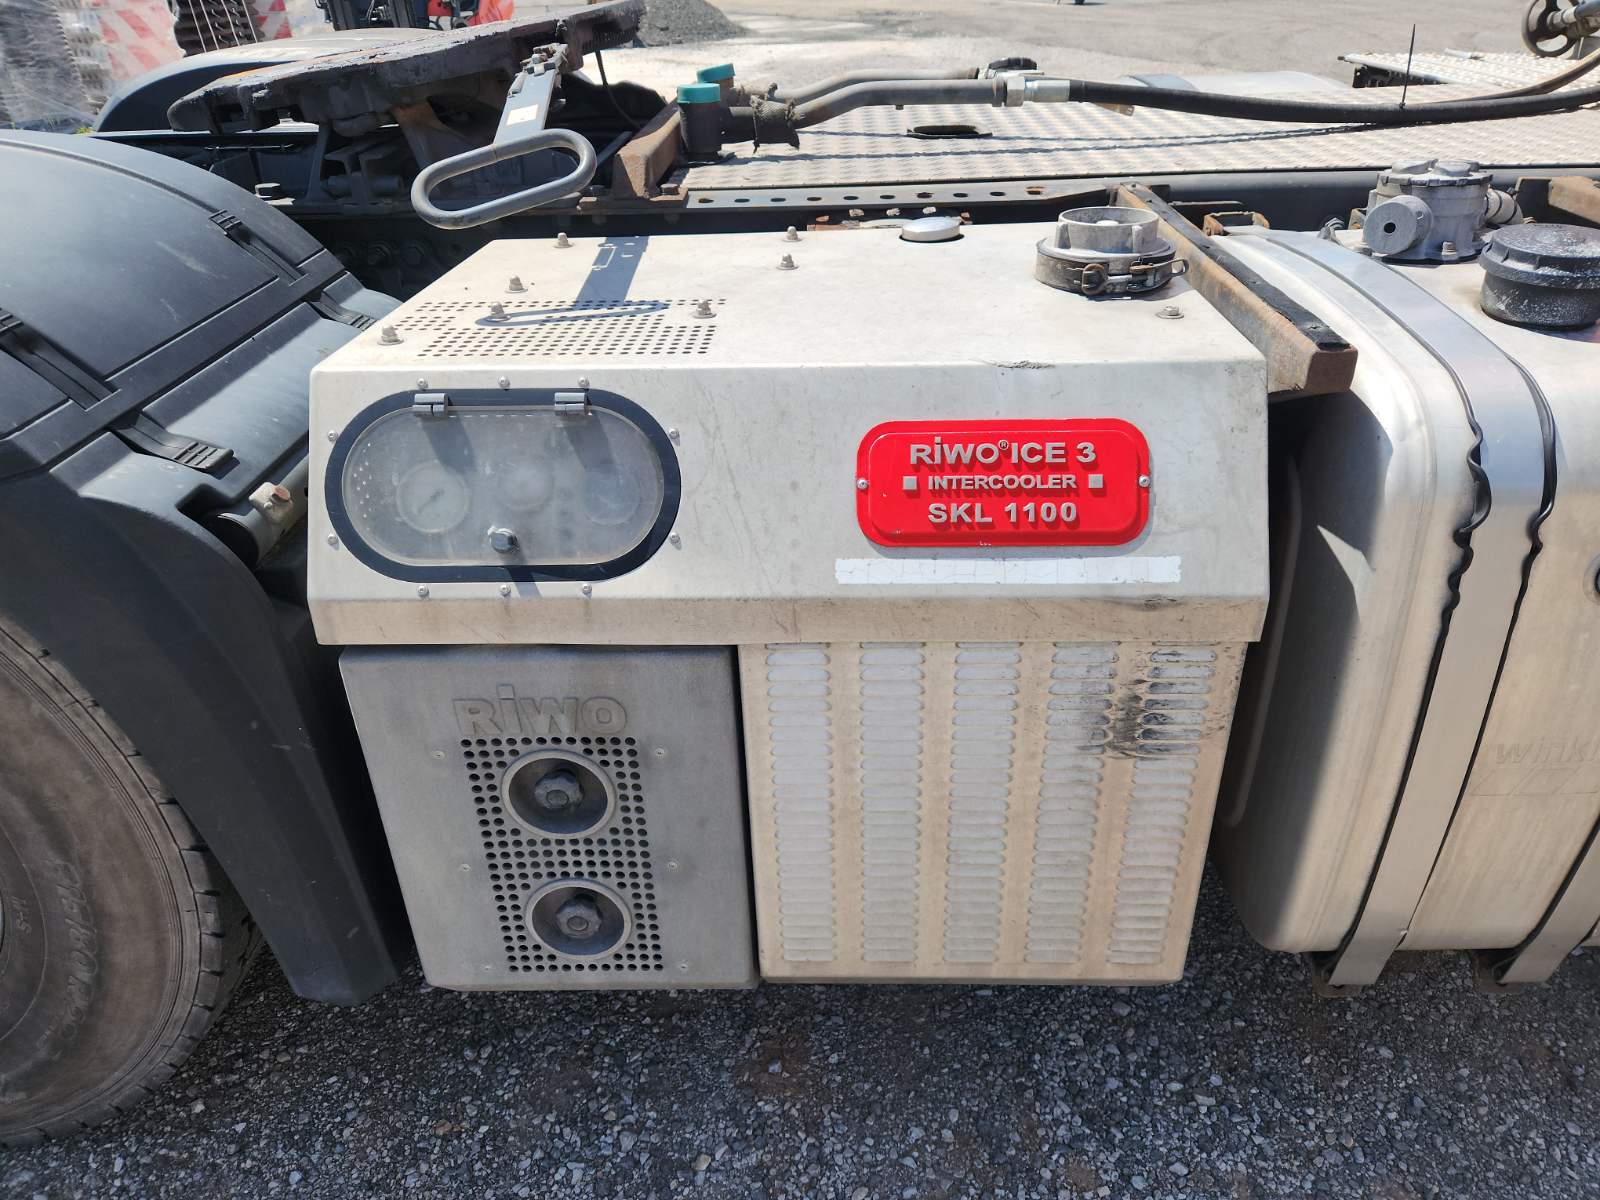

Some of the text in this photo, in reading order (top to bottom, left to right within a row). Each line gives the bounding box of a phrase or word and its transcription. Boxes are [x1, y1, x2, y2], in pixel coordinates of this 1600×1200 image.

[1011, 442, 1066, 463] ICE
[1076, 442, 1097, 463] 3
[928, 474, 1077, 490] INTERCOOLER
[928, 502, 1077, 523] SKL 1100
